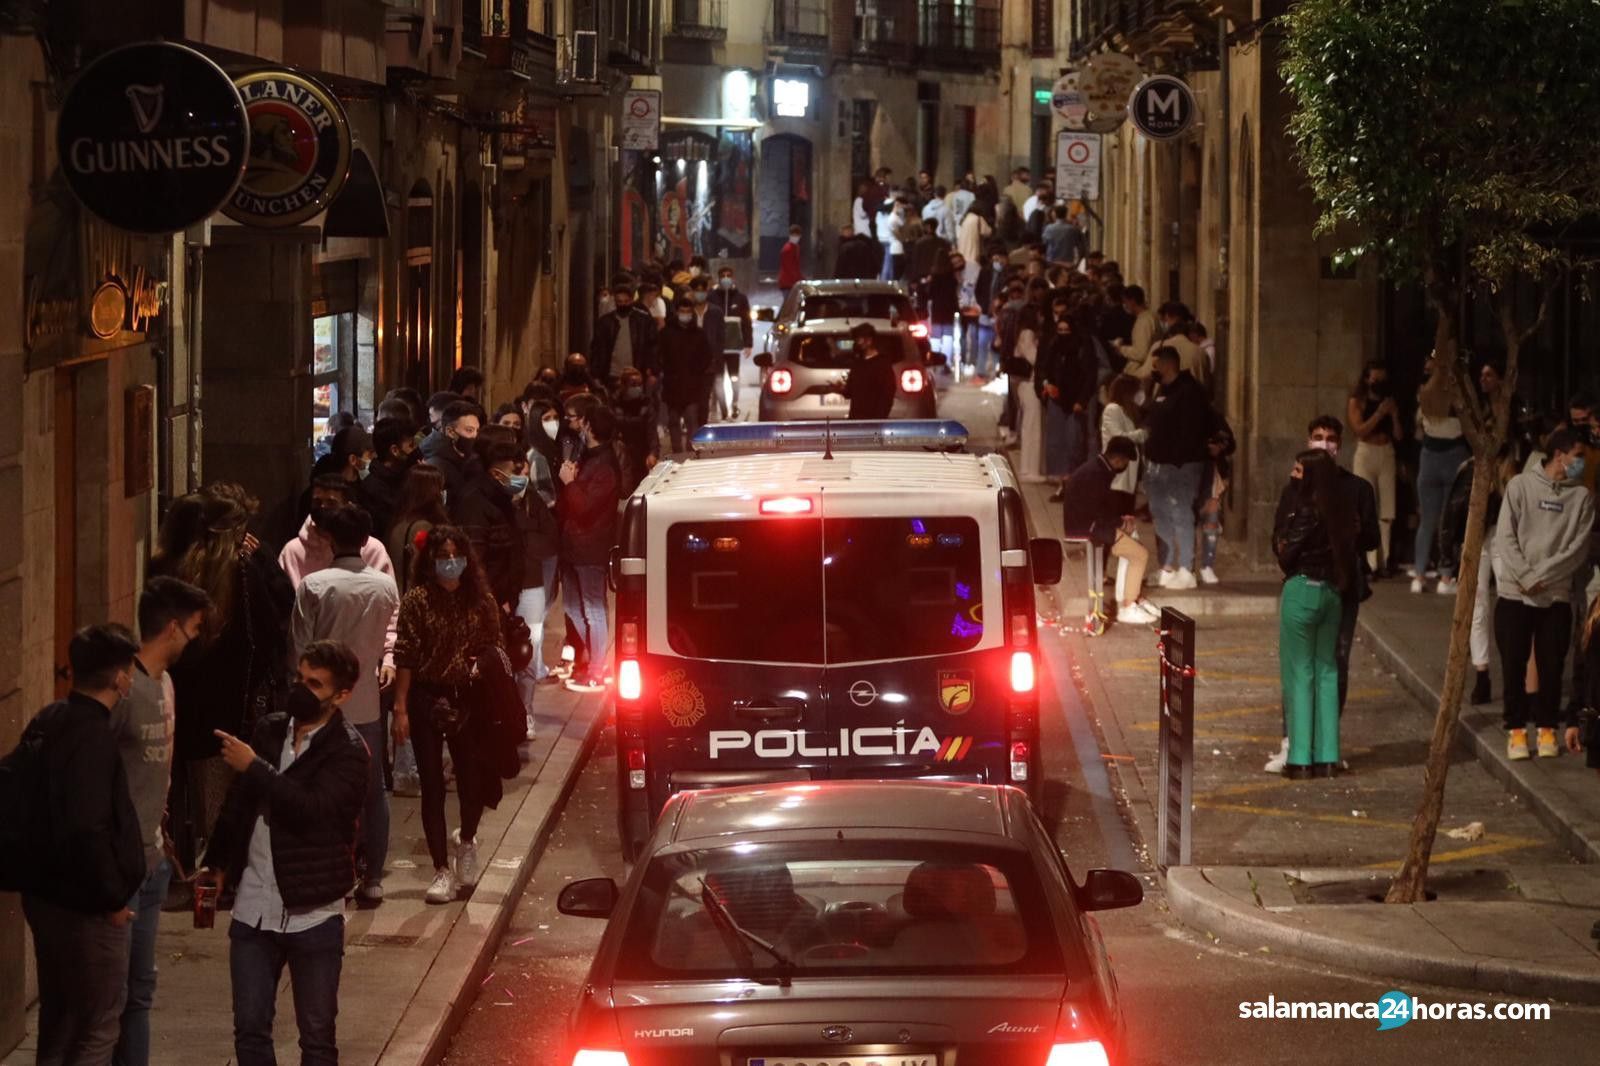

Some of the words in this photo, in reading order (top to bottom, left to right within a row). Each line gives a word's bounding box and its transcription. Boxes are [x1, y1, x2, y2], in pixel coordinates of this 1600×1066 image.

[241, 80, 333, 133] LANER
[1147, 88, 1180, 121] M
[70, 133, 231, 174] GUINNESS
[709, 719, 941, 759] POLICÍA
[634, 1028, 694, 1039] HYUNDAI
[987, 1022, 1043, 1034] Accent
